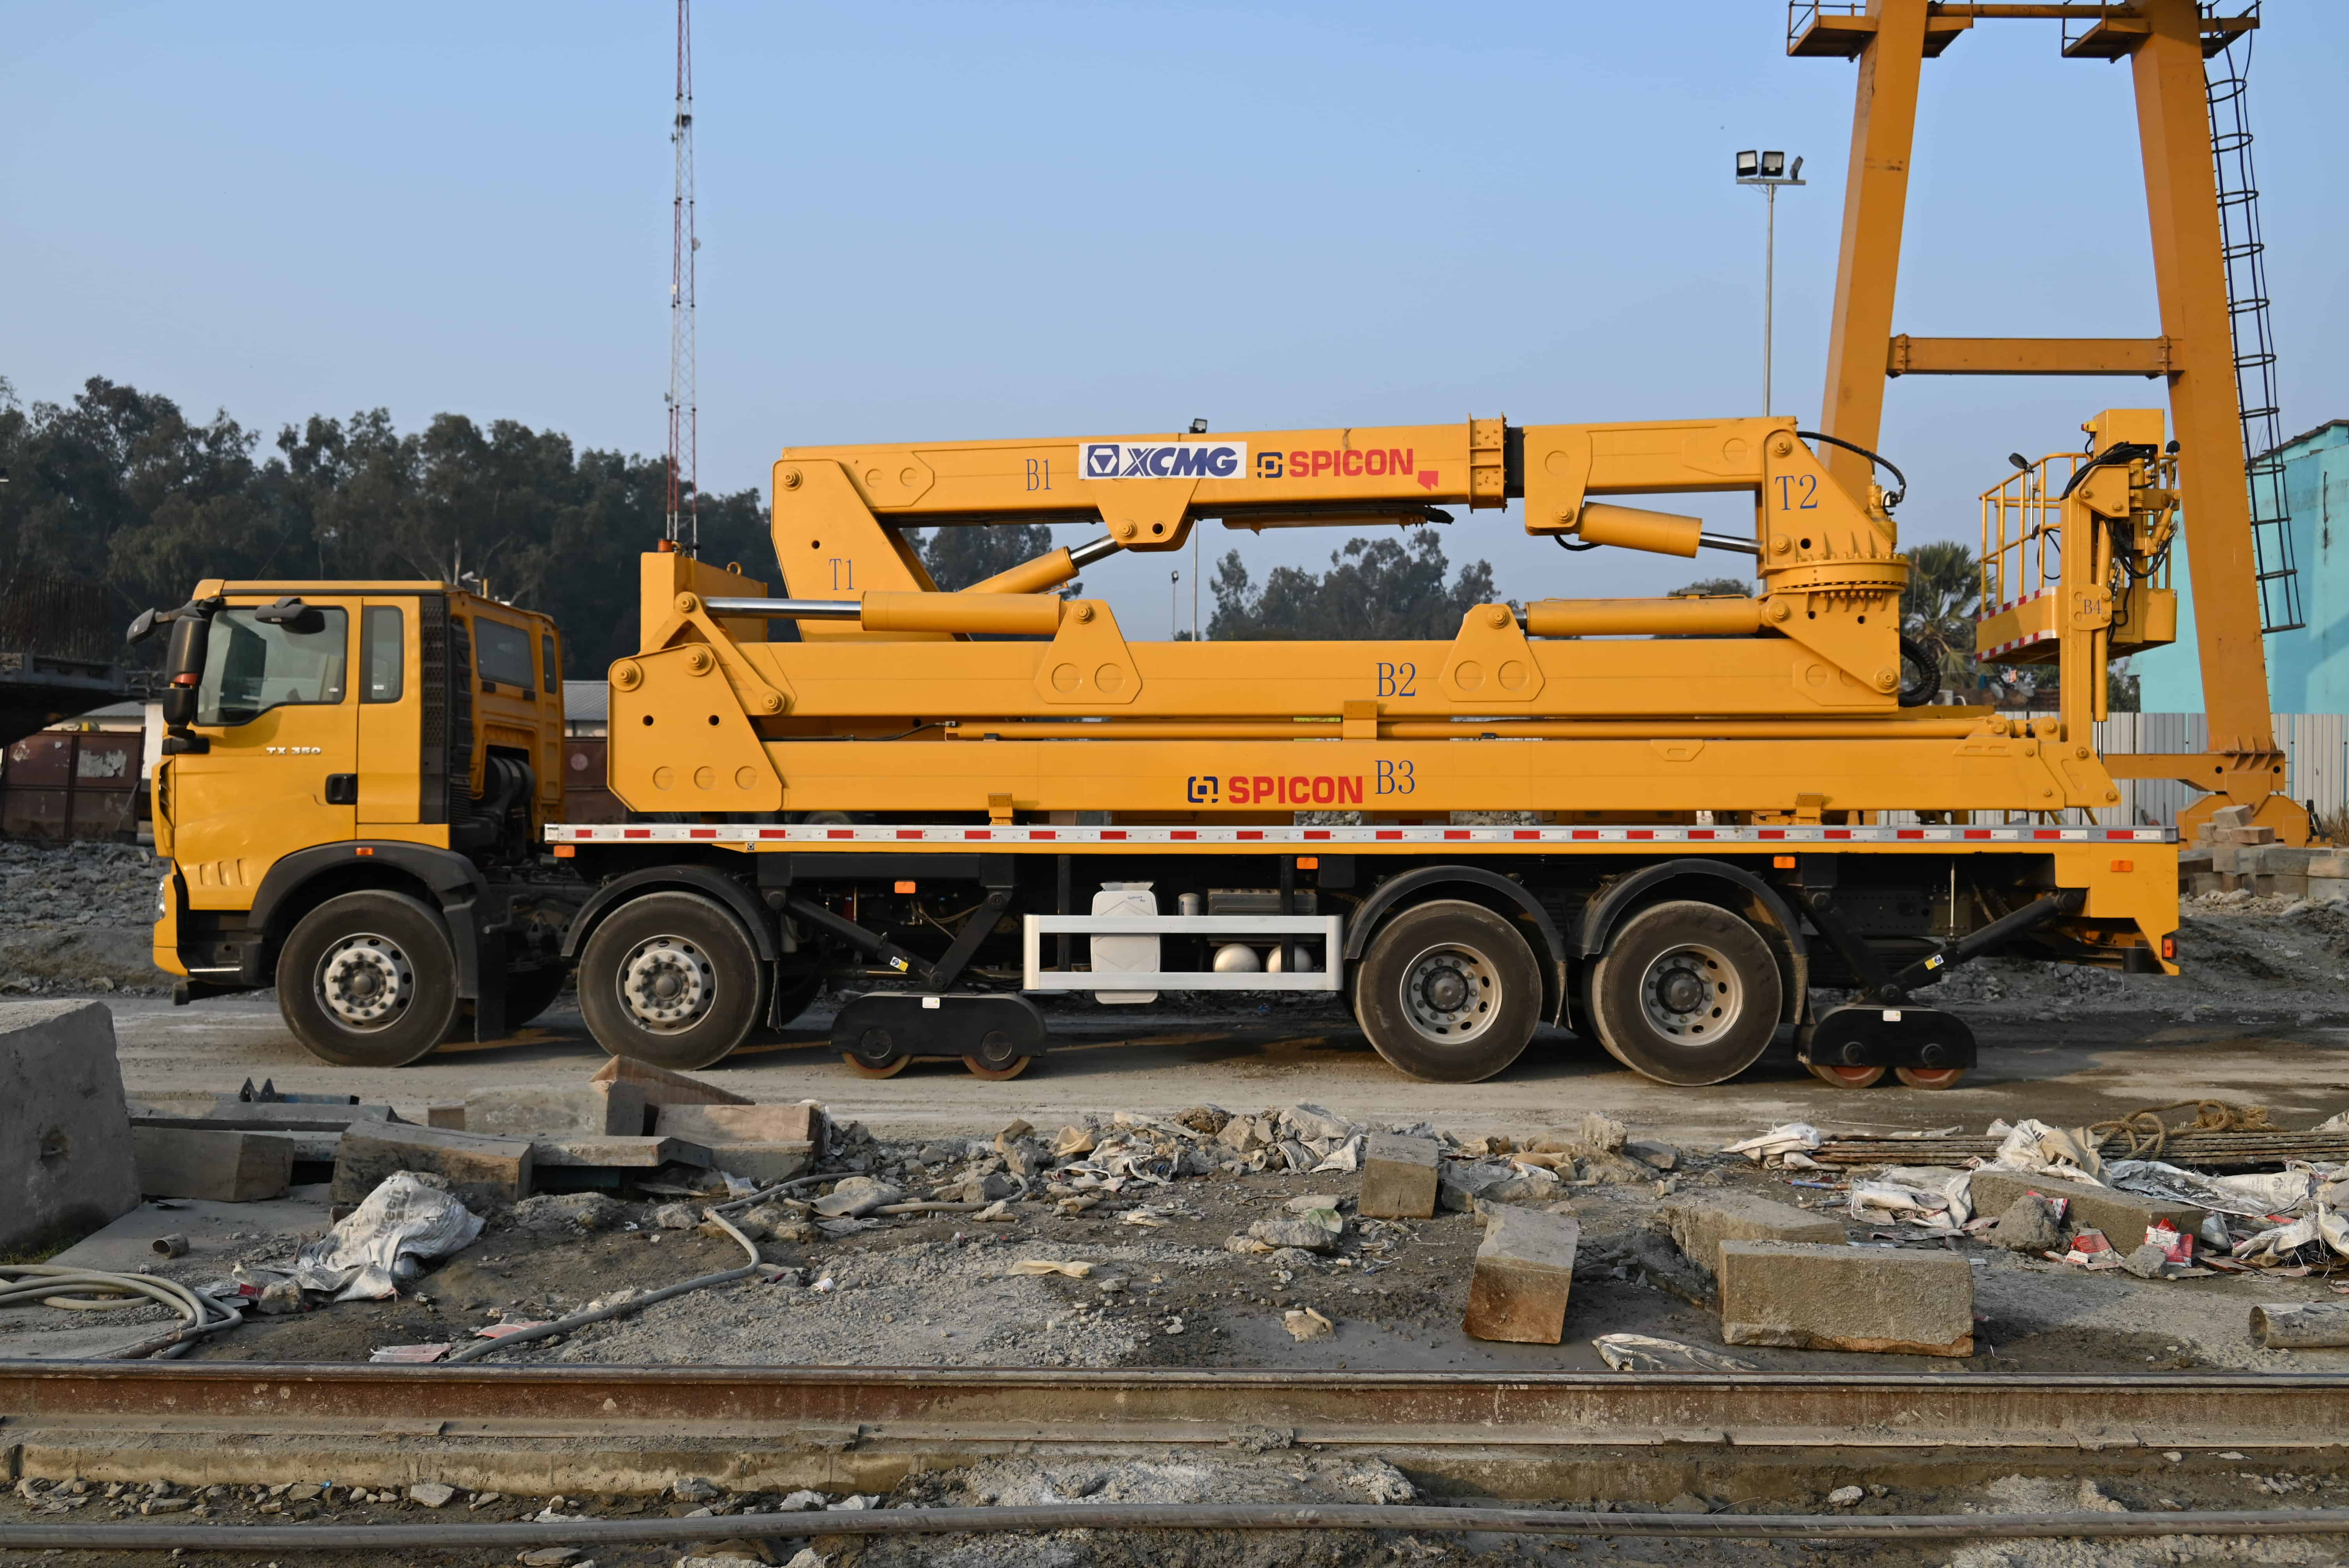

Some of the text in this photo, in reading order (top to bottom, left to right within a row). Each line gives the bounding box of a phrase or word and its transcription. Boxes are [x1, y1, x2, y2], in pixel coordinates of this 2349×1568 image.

[1027, 459, 1052, 491] B1
[1122, 448, 1237, 477] XCMG
[1289, 449, 1413, 477] SPICON
[1775, 475, 1818, 510] T2
[829, 559, 855, 590] T1
[2084, 599, 2101, 614] B4
[1377, 663, 1416, 697] B2
[1229, 776, 1363, 804] SPICON
[1375, 760, 1415, 794] B3
